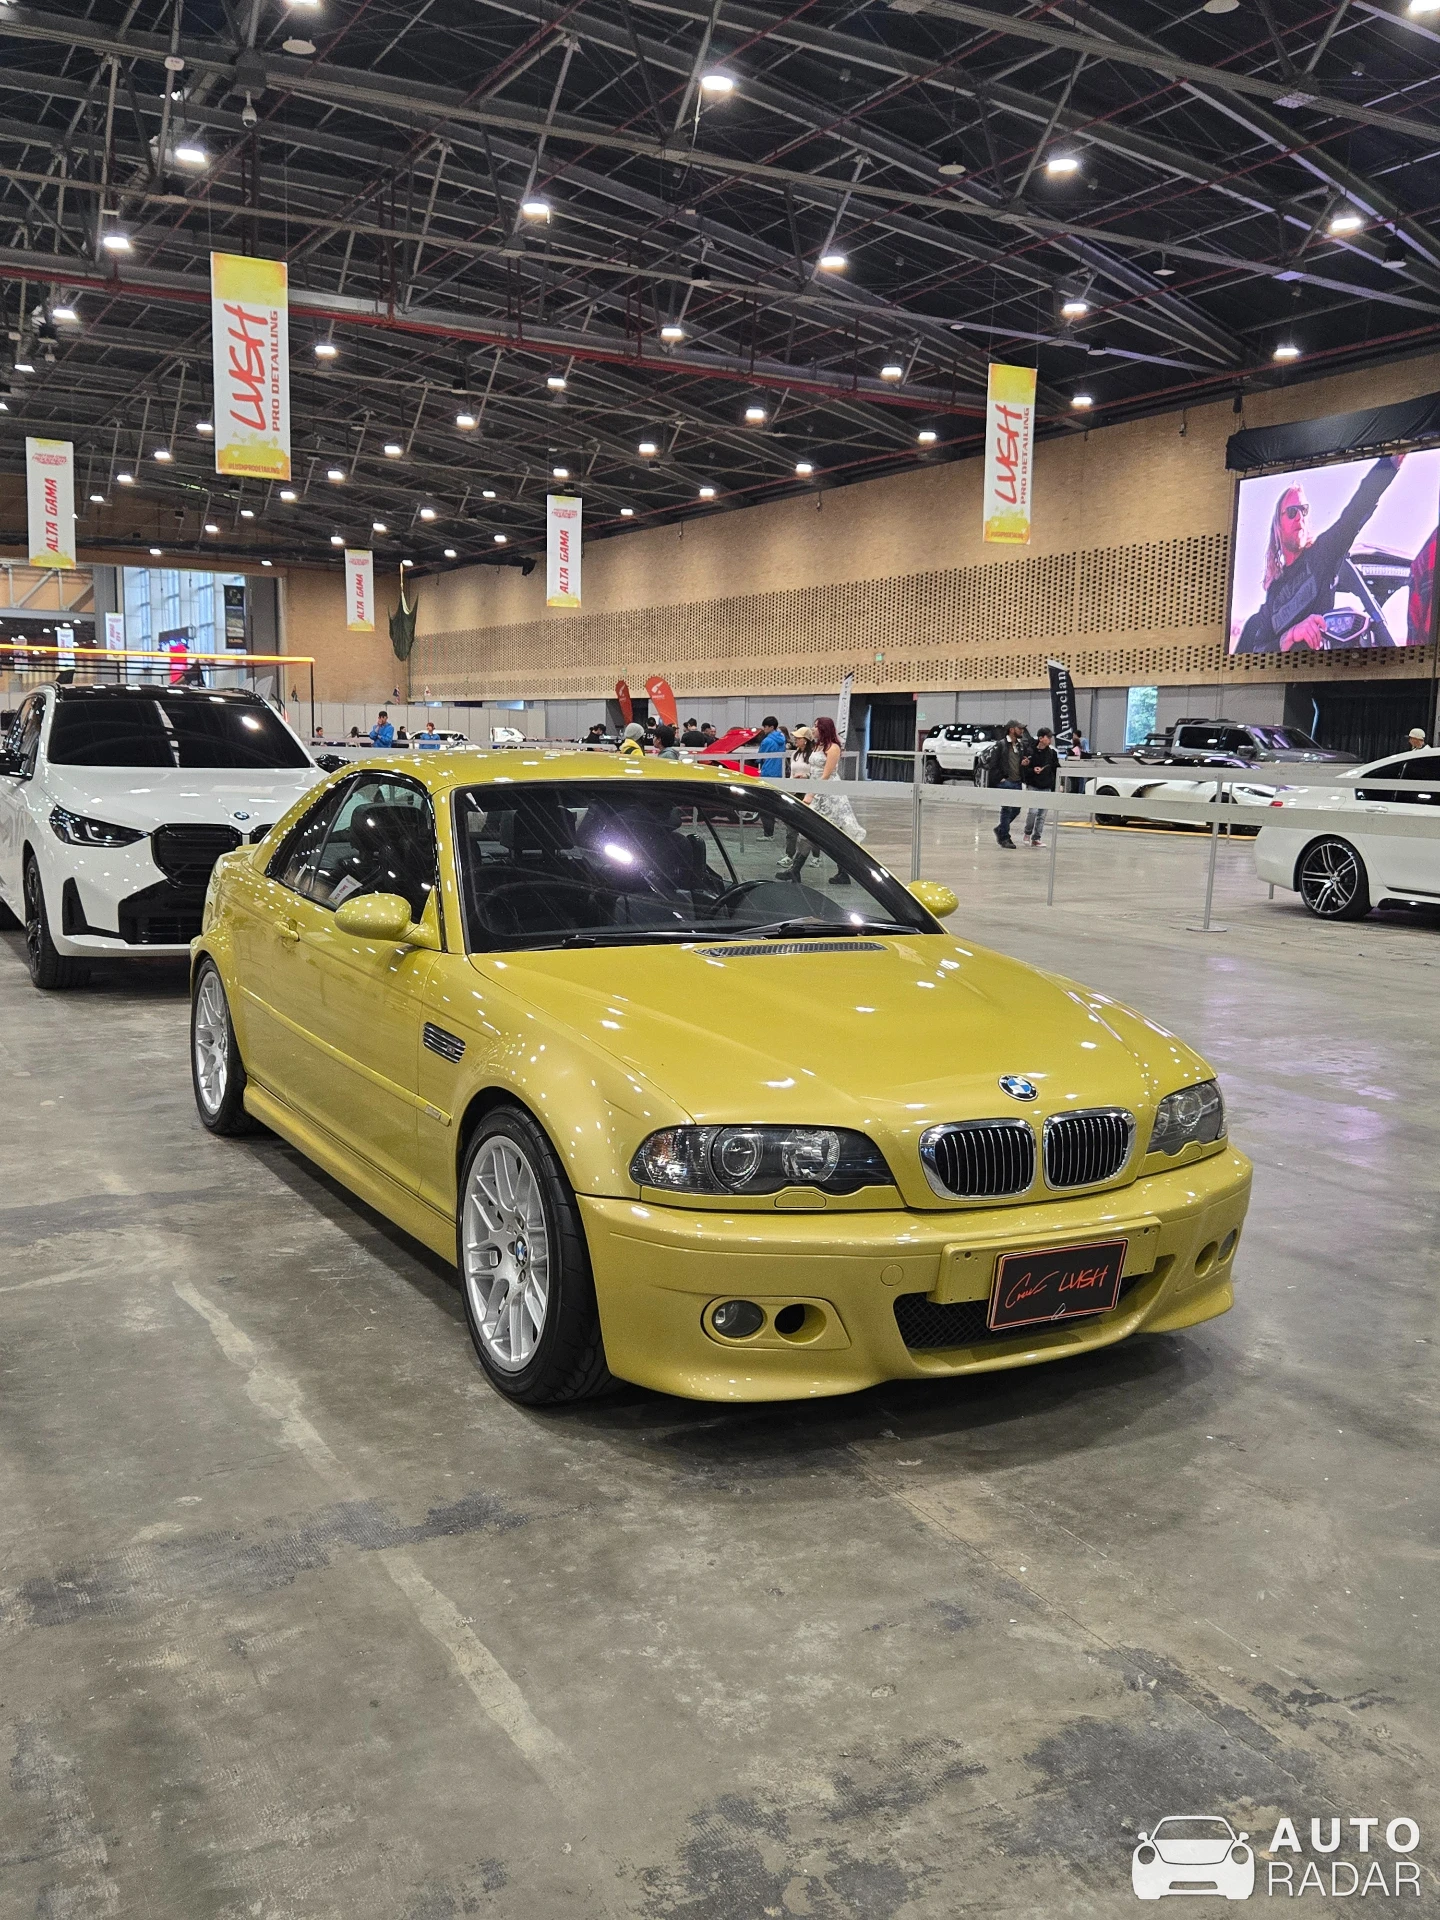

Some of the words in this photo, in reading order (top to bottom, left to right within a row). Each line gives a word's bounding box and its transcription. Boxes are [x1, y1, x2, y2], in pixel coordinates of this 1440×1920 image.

[223, 303, 269, 431] LUSH
[269, 310, 280, 395] DETAILING
[271, 398, 281, 432] PRO
[994, 403, 1023, 505] LUSH
[1021, 407, 1030, 475] DETAILING
[44, 477, 58, 516] GAMA
[45, 521, 59, 553] ALTA
[559, 529, 569, 562] GAMA
[355, 573, 364, 598] GAMA
[559, 566, 569, 594] ALTA
[356, 600, 365, 621] ALTA
[1056, 671, 1074, 743] Autoclan
[1058, 1264, 1109, 1292] LUSH
